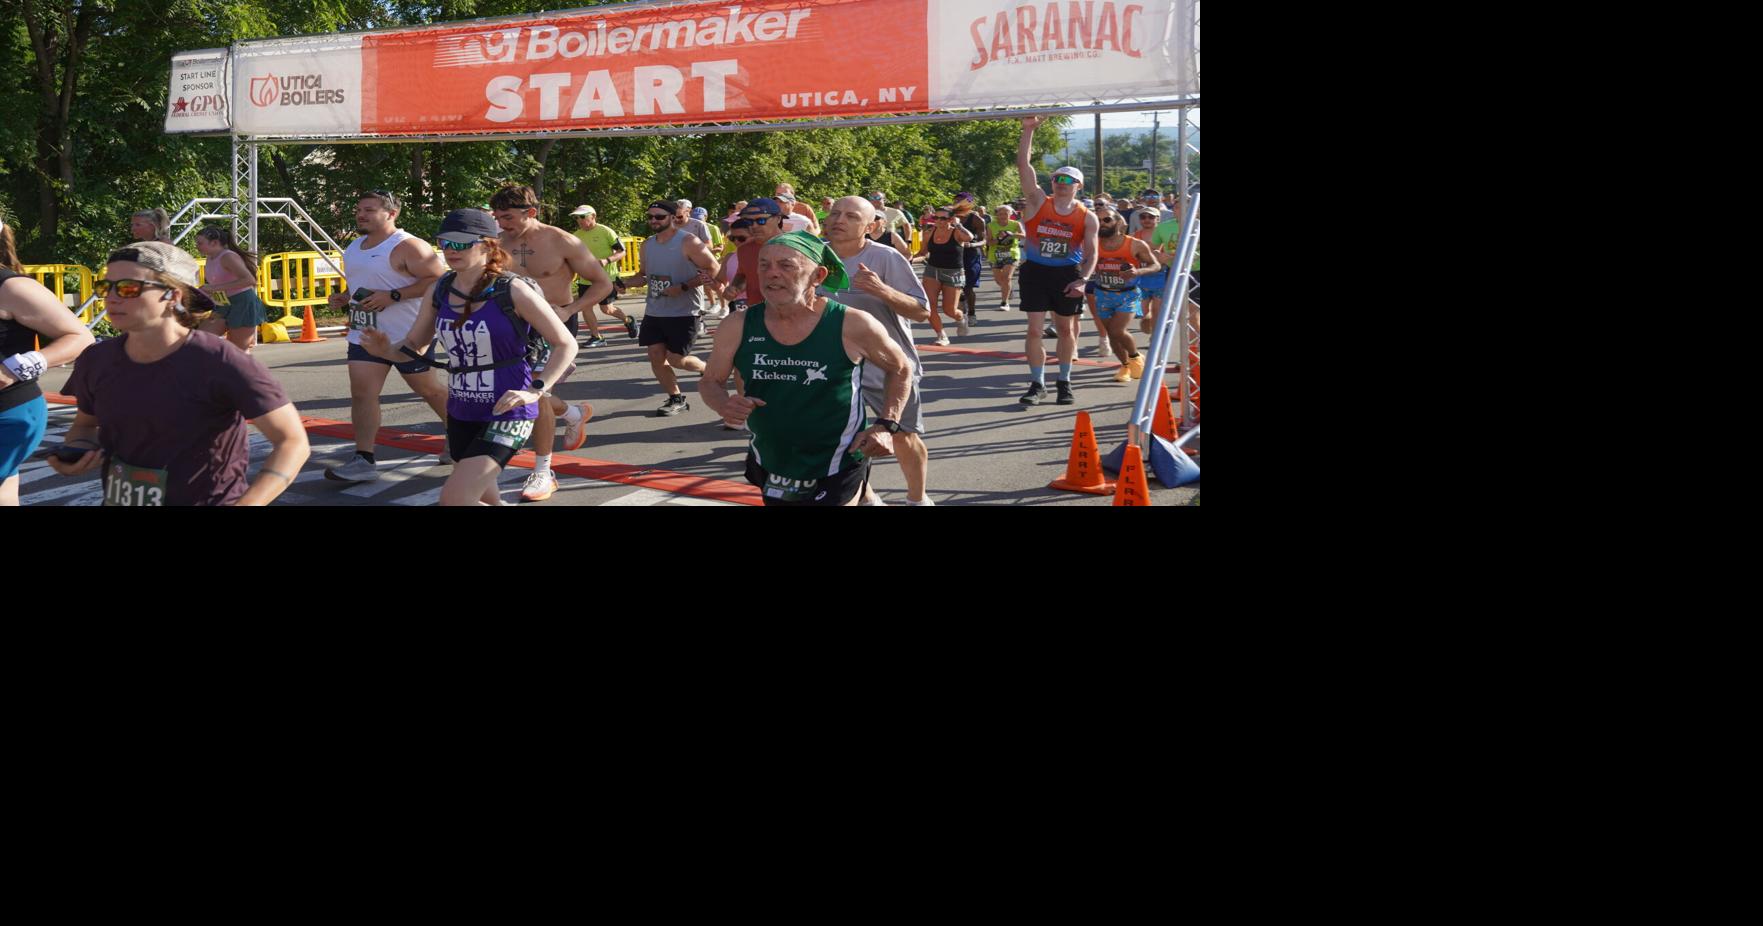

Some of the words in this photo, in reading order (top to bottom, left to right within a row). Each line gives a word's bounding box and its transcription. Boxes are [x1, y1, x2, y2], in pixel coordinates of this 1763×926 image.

[526, 5, 811, 60] Boilermaker
[969, 0, 1143, 71] SARANAC
[181, 71, 198, 80] START
[201, 71, 216, 79] LINE
[280, 74, 322, 91] UTICA
[183, 82, 214, 91] SPONSOR
[484, 59, 738, 123] START
[191, 94, 225, 112] GPO
[280, 88, 345, 106] BOILERS
[781, 89, 868, 108] UTICA,
[878, 86, 917, 103] NY
[1040, 241, 1067, 253] 7821
[349, 309, 374, 326] 7491
[435, 316, 488, 333] UTCA
[752, 353, 819, 368] Kuyahoora
[752, 369, 798, 381] Kickers
[107, 473, 163, 506] 11313
